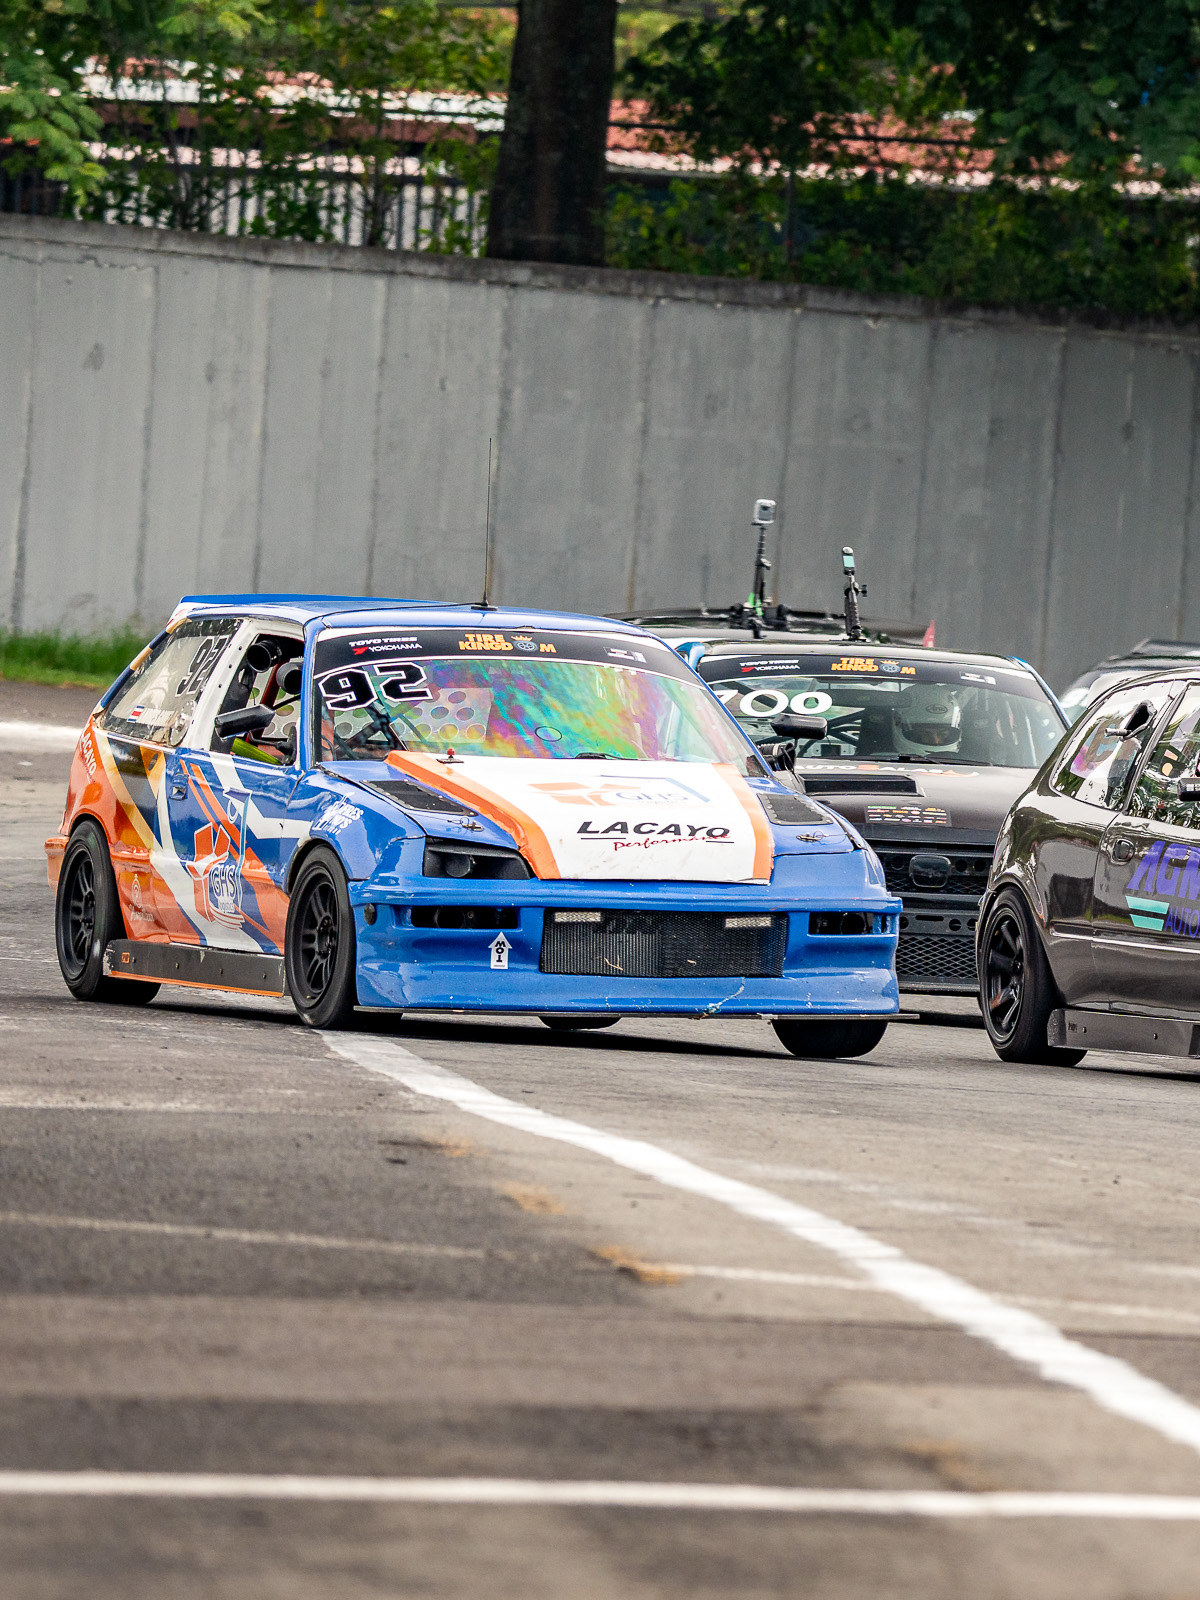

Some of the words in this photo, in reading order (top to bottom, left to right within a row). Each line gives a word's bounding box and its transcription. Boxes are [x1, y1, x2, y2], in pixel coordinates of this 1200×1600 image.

[349, 638, 381, 647] TOYO
[464, 633, 504, 643] TIRE
[368, 643, 422, 653] YOKOHAMA
[840, 657, 874, 666] TIRE
[318, 662, 433, 711] 92
[577, 821, 730, 838] LACAYO
[212, 864, 237, 899] GHS
[495, 941, 506, 963] TOW
